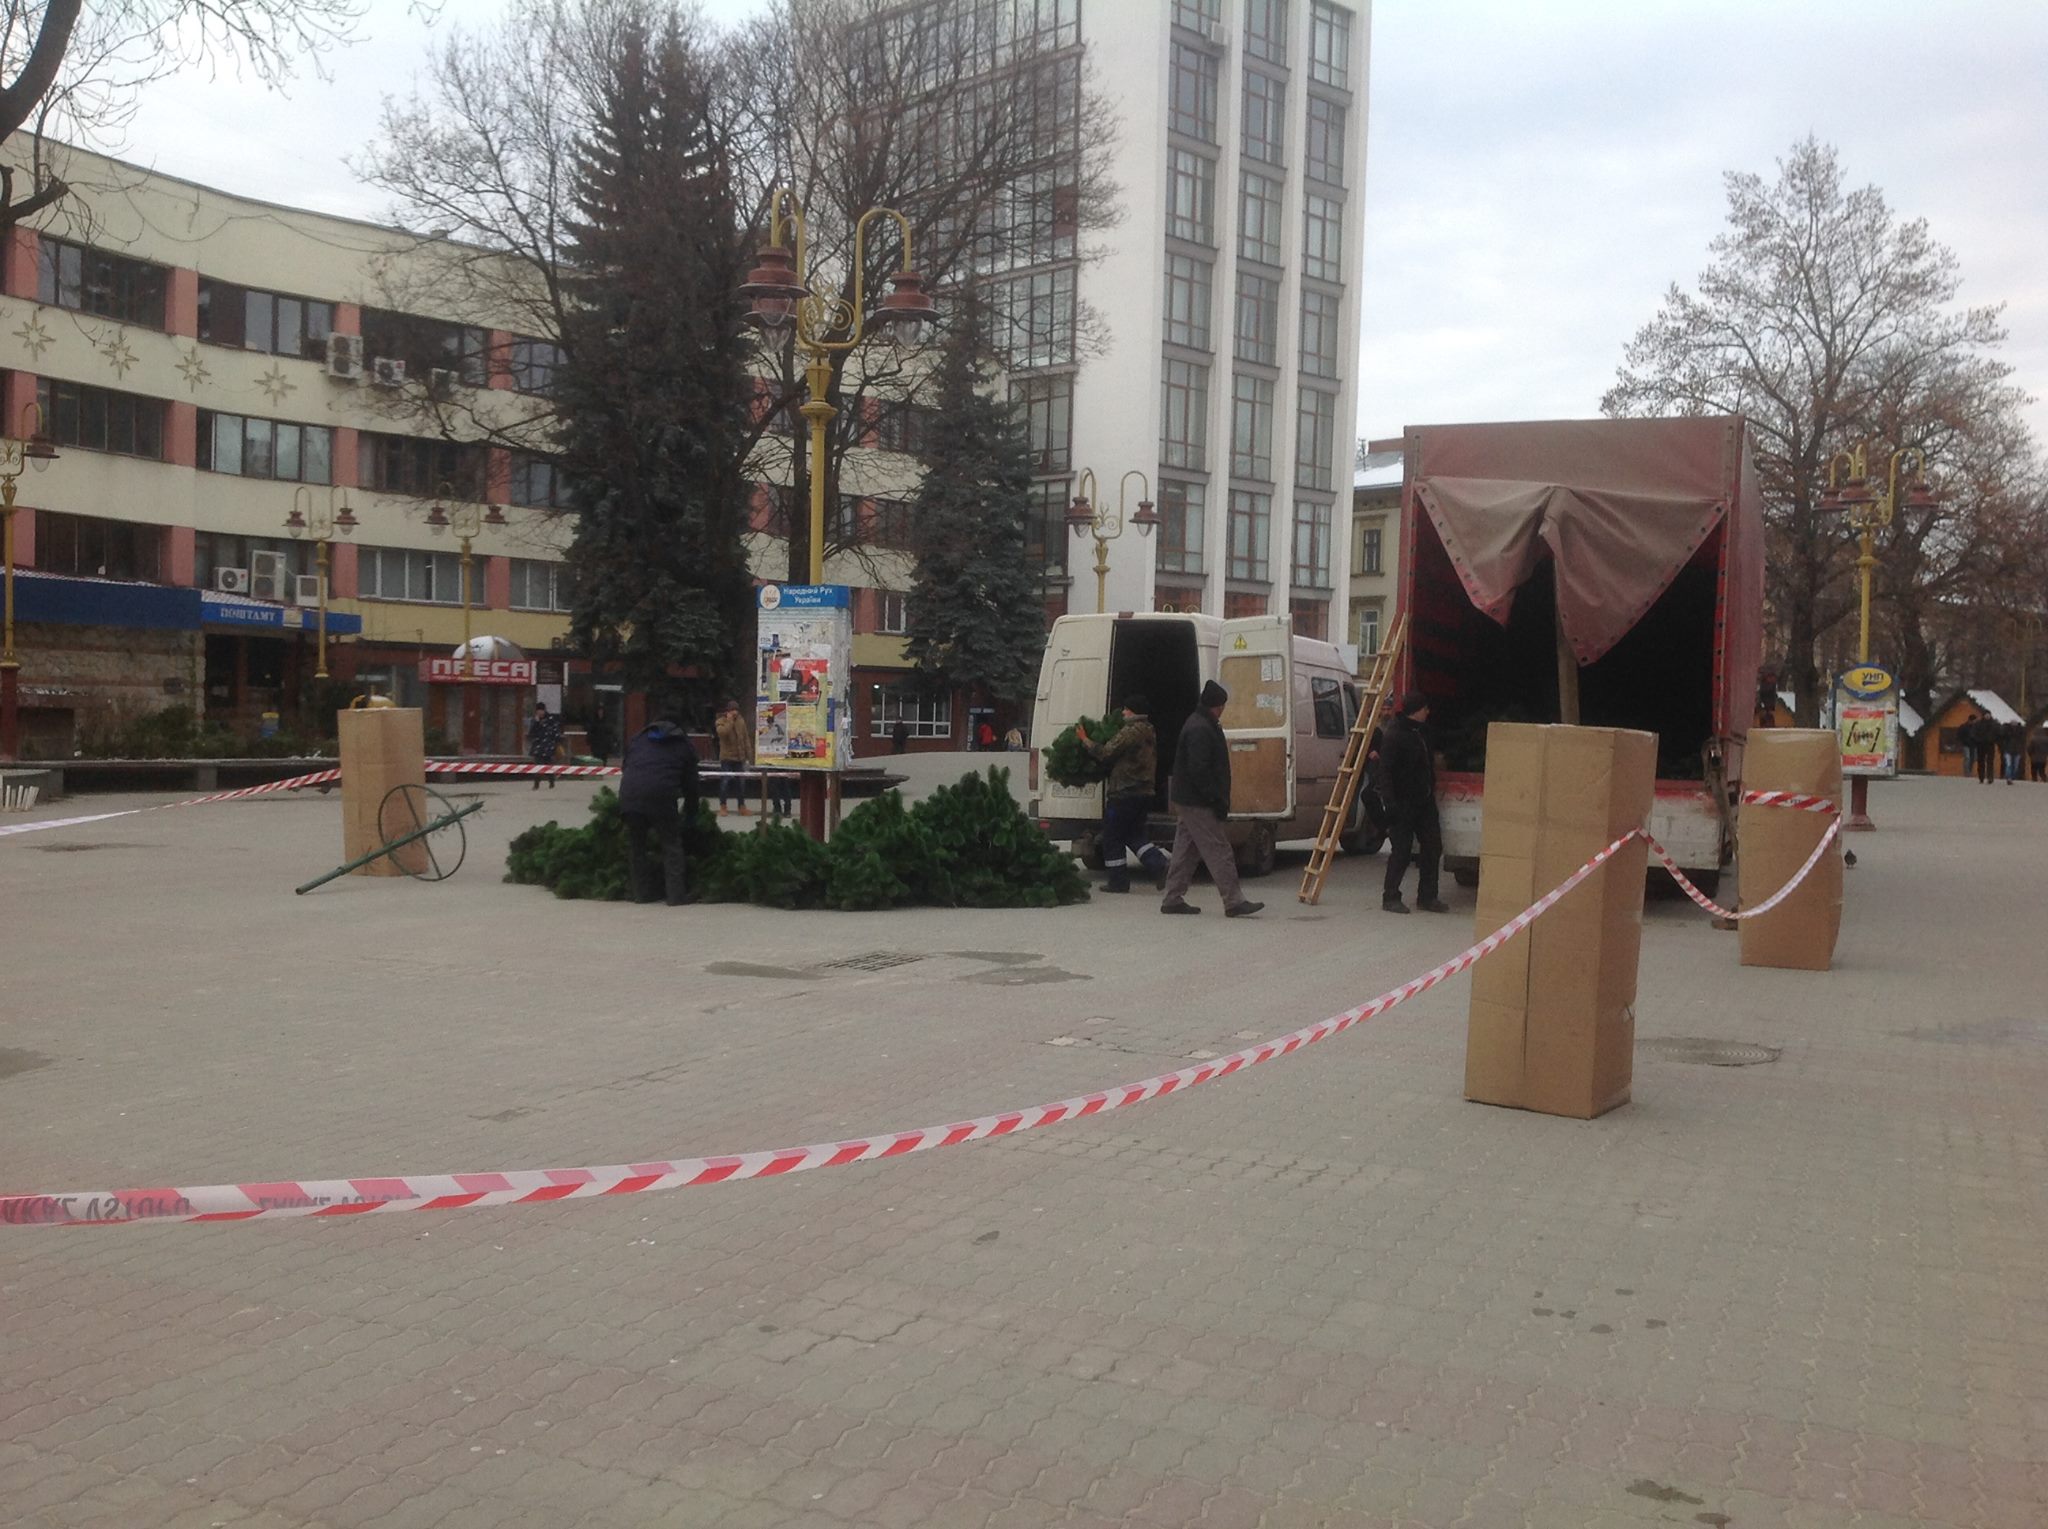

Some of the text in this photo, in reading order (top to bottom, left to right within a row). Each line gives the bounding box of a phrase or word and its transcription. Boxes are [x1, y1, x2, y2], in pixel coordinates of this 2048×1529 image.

[220, 607, 275, 622] ПОШТАМТ
[431, 658, 530, 677] ПРЕСА
[1862, 672, 1884, 681] УНП
